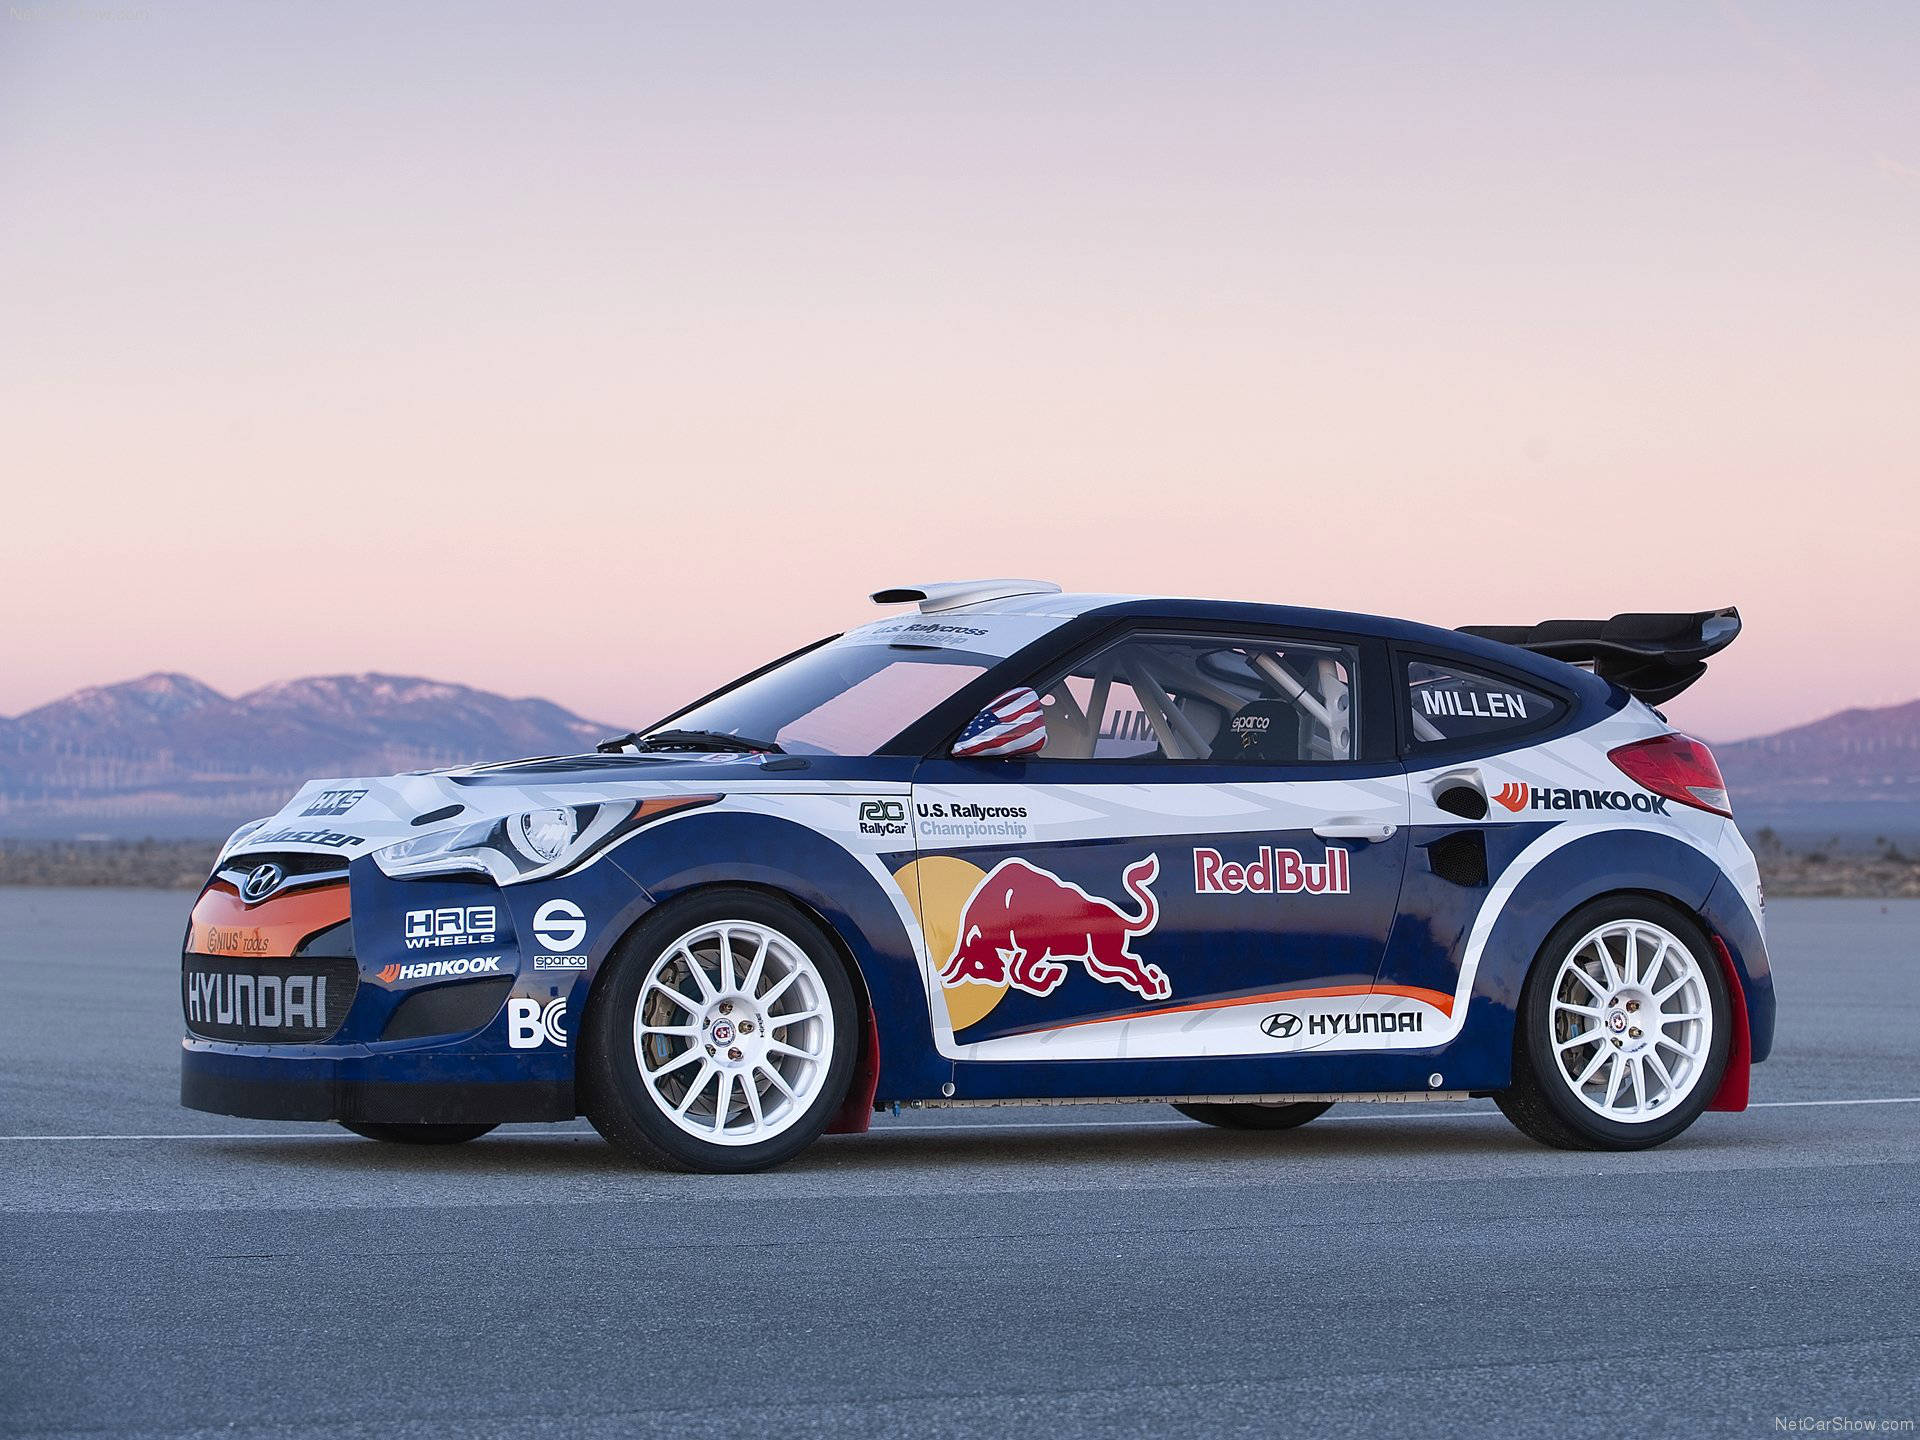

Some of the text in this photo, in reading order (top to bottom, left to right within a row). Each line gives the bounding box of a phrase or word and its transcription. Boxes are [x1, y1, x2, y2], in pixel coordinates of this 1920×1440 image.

[904, 623, 989, 636] Rallycross
[1421, 690, 1528, 719] MILLEN
[1232, 716, 1270, 732] sparco
[916, 803, 1028, 821] U.S. Rallycross
[920, 820, 1028, 839] Championship
[1193, 846, 1350, 895] Red Bull
[405, 905, 496, 938] HRE
[243, 938, 270, 953] TOOLS
[405, 933, 496, 950] WHEELS
[535, 956, 586, 969] sparco
[189, 972, 327, 1028] HYUNDAI
[1309, 1011, 1423, 1035] HYUNDAI
